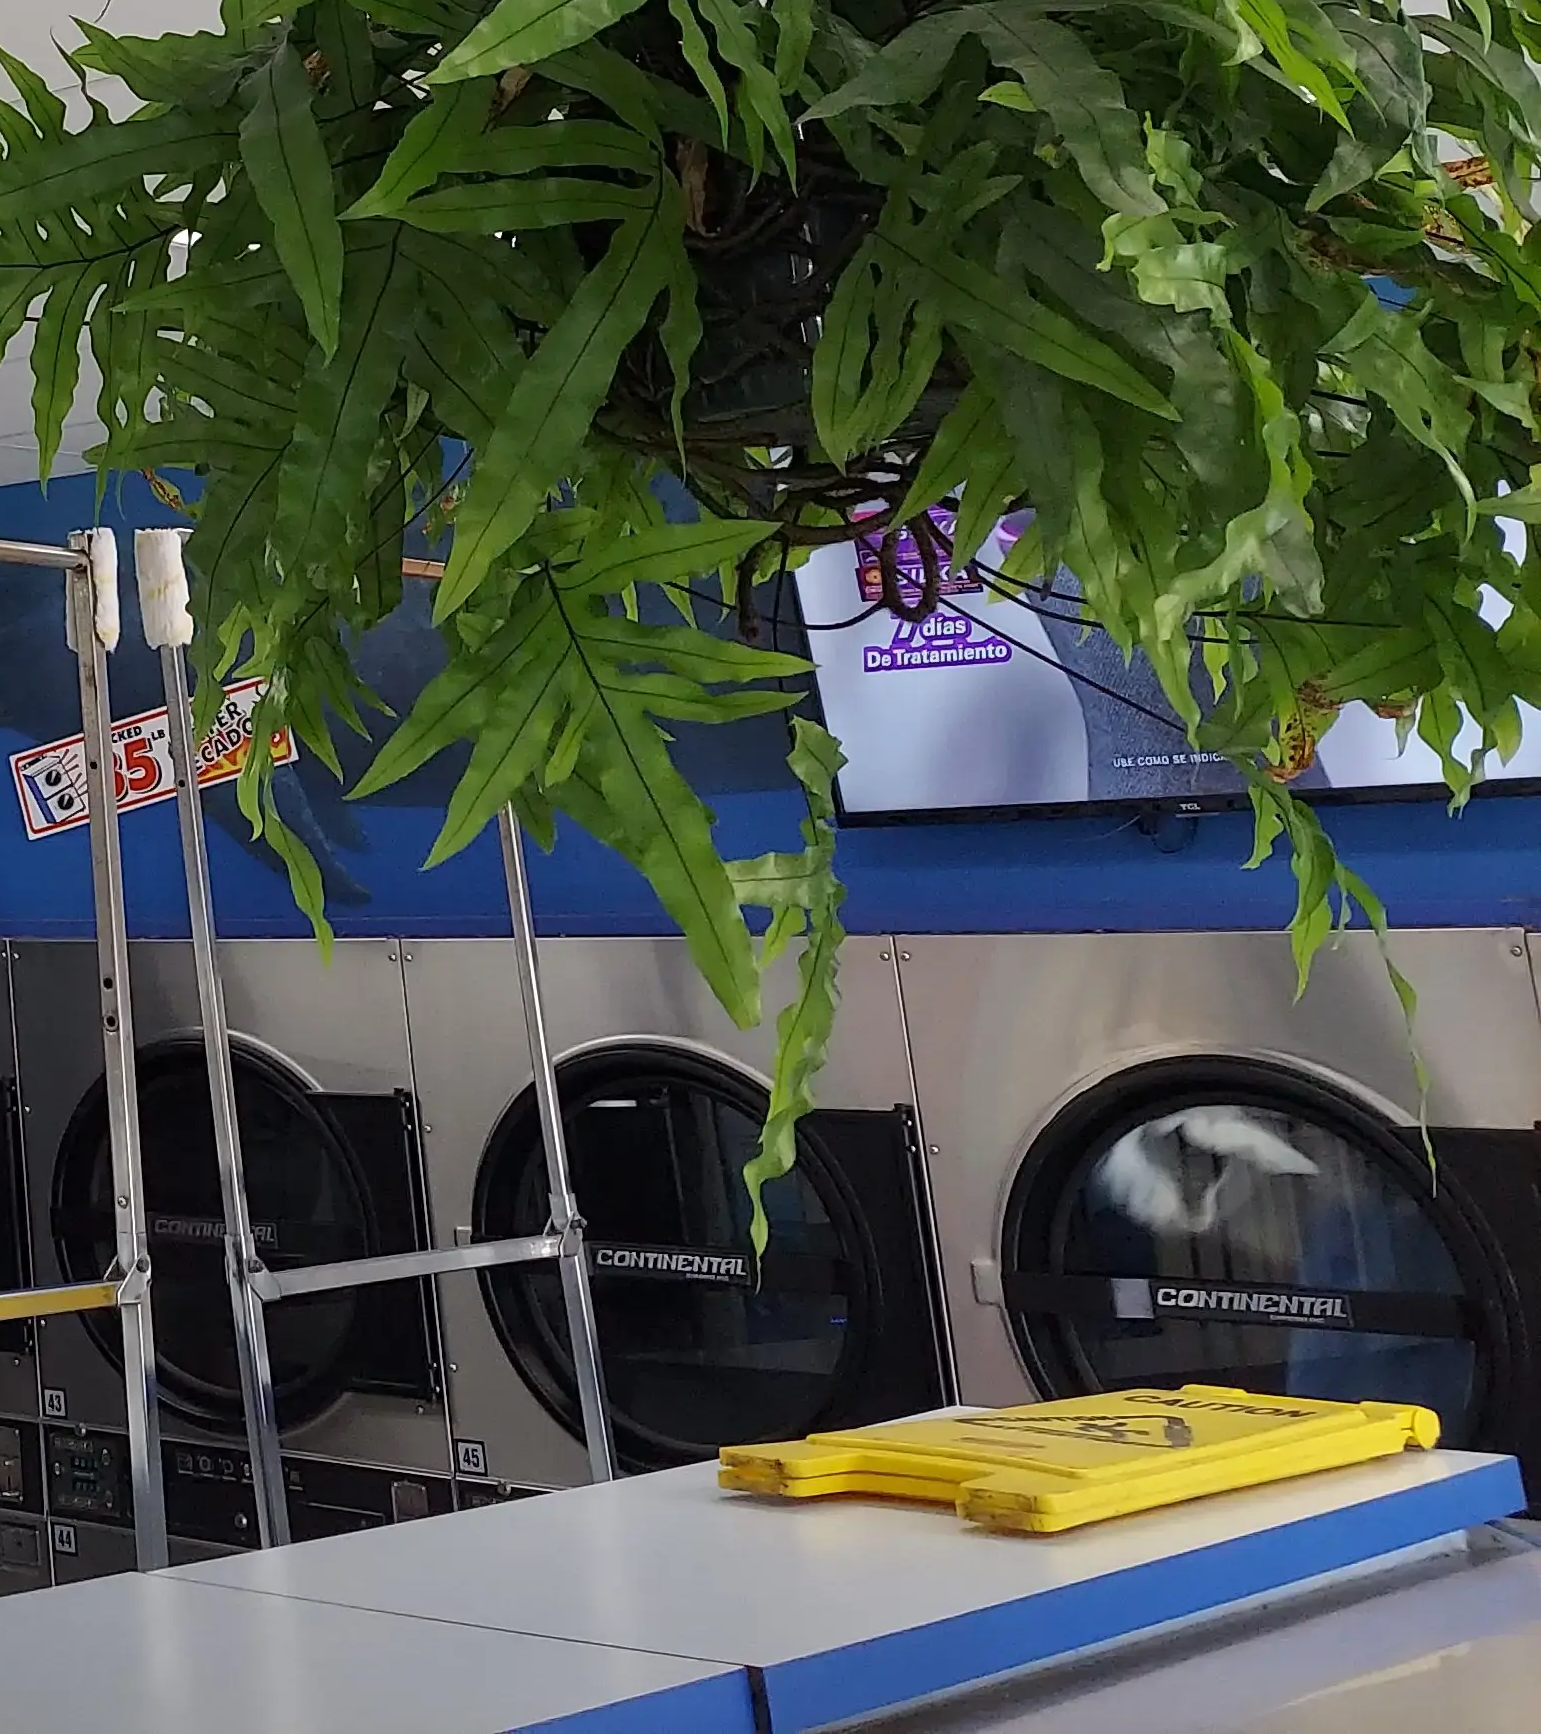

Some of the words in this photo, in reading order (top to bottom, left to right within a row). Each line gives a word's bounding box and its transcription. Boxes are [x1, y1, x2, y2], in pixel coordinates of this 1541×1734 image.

[922, 617, 967, 637] días
[867, 651, 892, 667] De
[893, 644, 1008, 666] Tratamiento
[596, 1249, 747, 1276] CONTINENTAL
[1156, 1288, 1347, 1318] CONTINENTAL
[48, 1394, 62, 1412] 43
[1123, 1394, 1317, 1418] CAUTION
[462, 1447, 480, 1468] 45
[57, 1530, 72, 1549] 44
